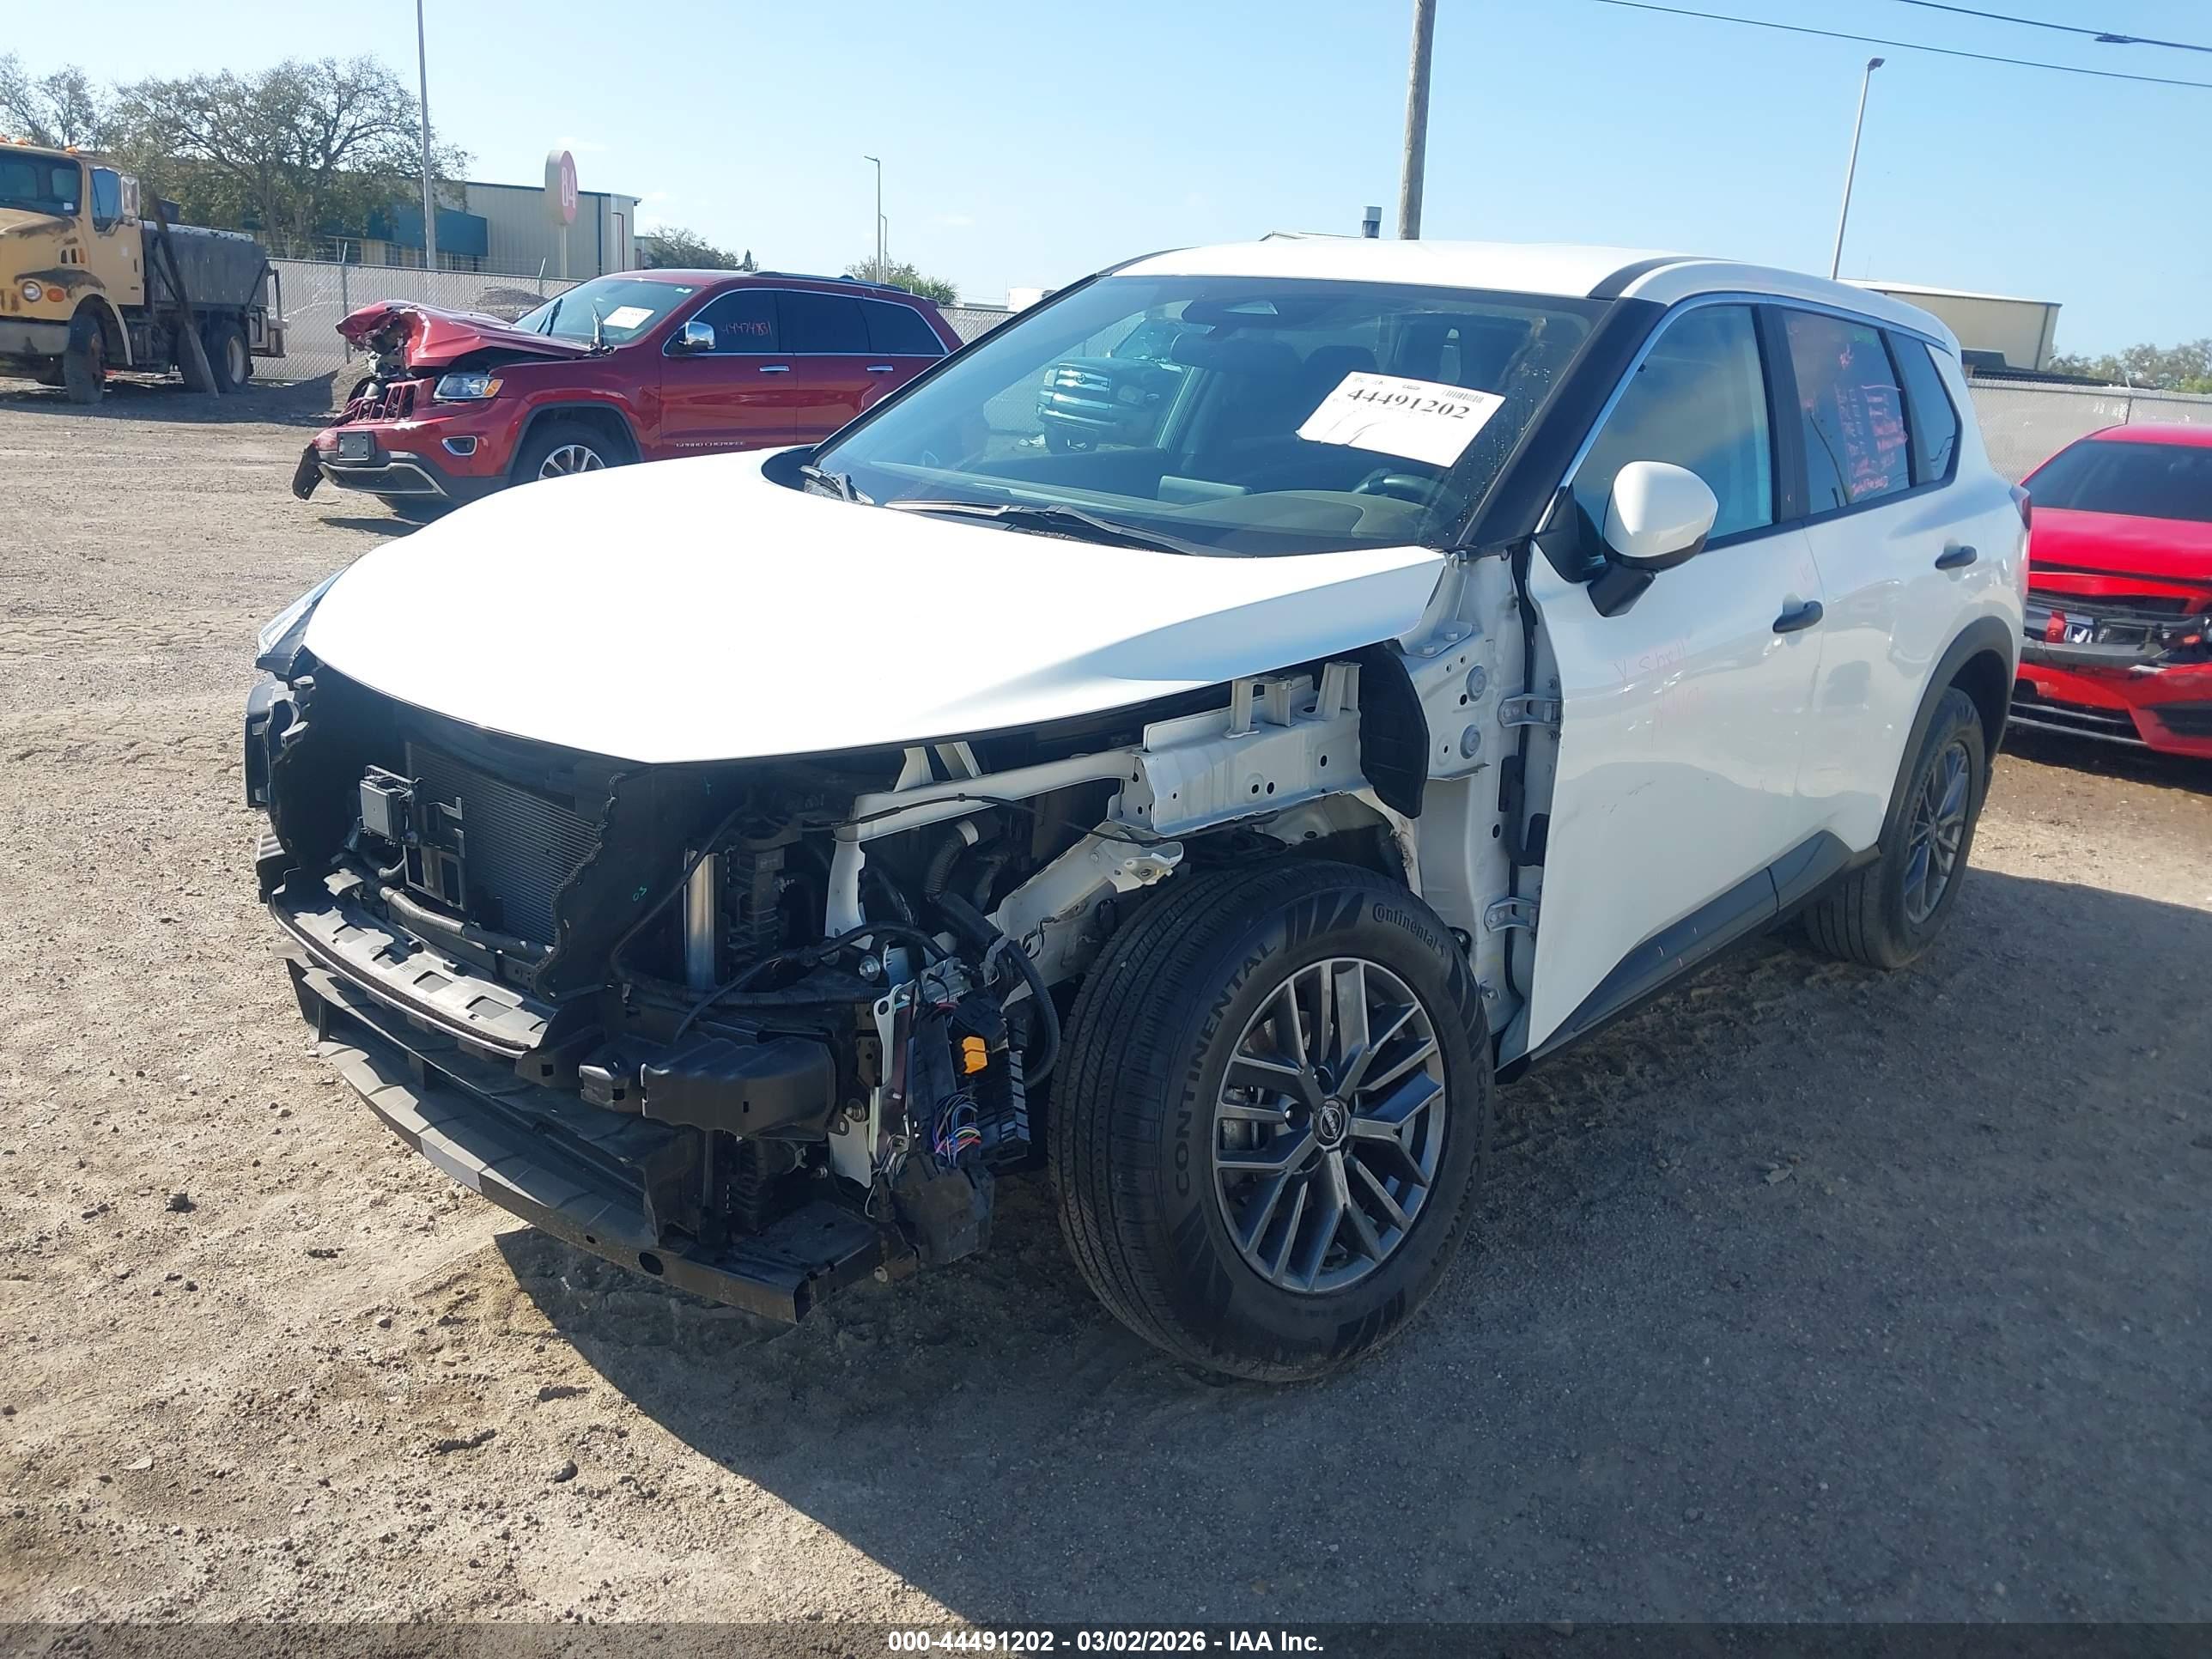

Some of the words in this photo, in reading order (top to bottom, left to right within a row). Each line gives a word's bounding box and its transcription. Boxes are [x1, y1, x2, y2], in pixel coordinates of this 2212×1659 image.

[562, 167, 576, 208] 84
[1347, 388, 1471, 419] 44491202
[1372, 902, 1438, 950] Continental
[1176, 941, 1277, 1197] CONTINENTAL
